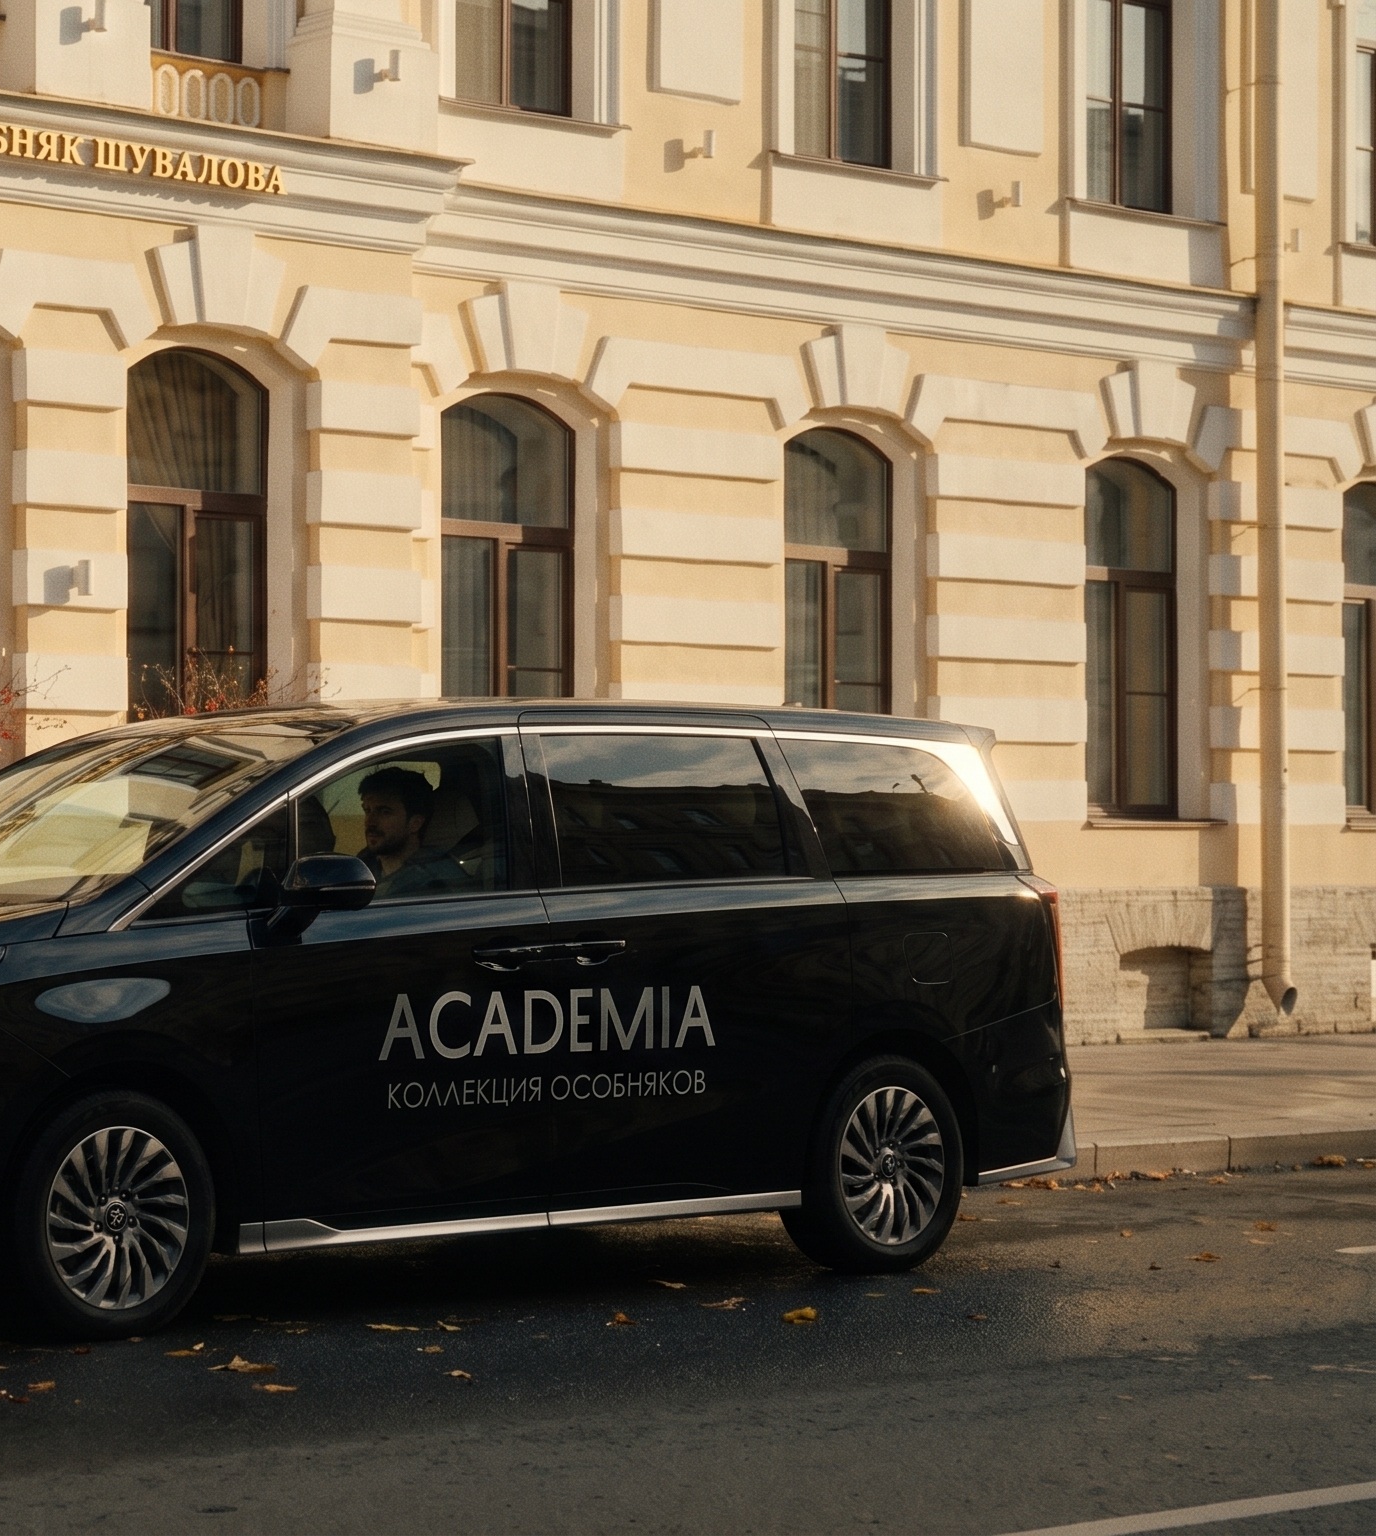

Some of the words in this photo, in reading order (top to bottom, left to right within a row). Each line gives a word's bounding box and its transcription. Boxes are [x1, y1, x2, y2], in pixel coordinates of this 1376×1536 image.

[94, 137, 288, 195] ШУВАЛОВА
[378, 985, 716, 1061] ACADEMIA
[387, 1076, 542, 1109] КОЛЛЕКЦИЯ
[550, 1069, 707, 1101] ОСОБНЯКОВ
